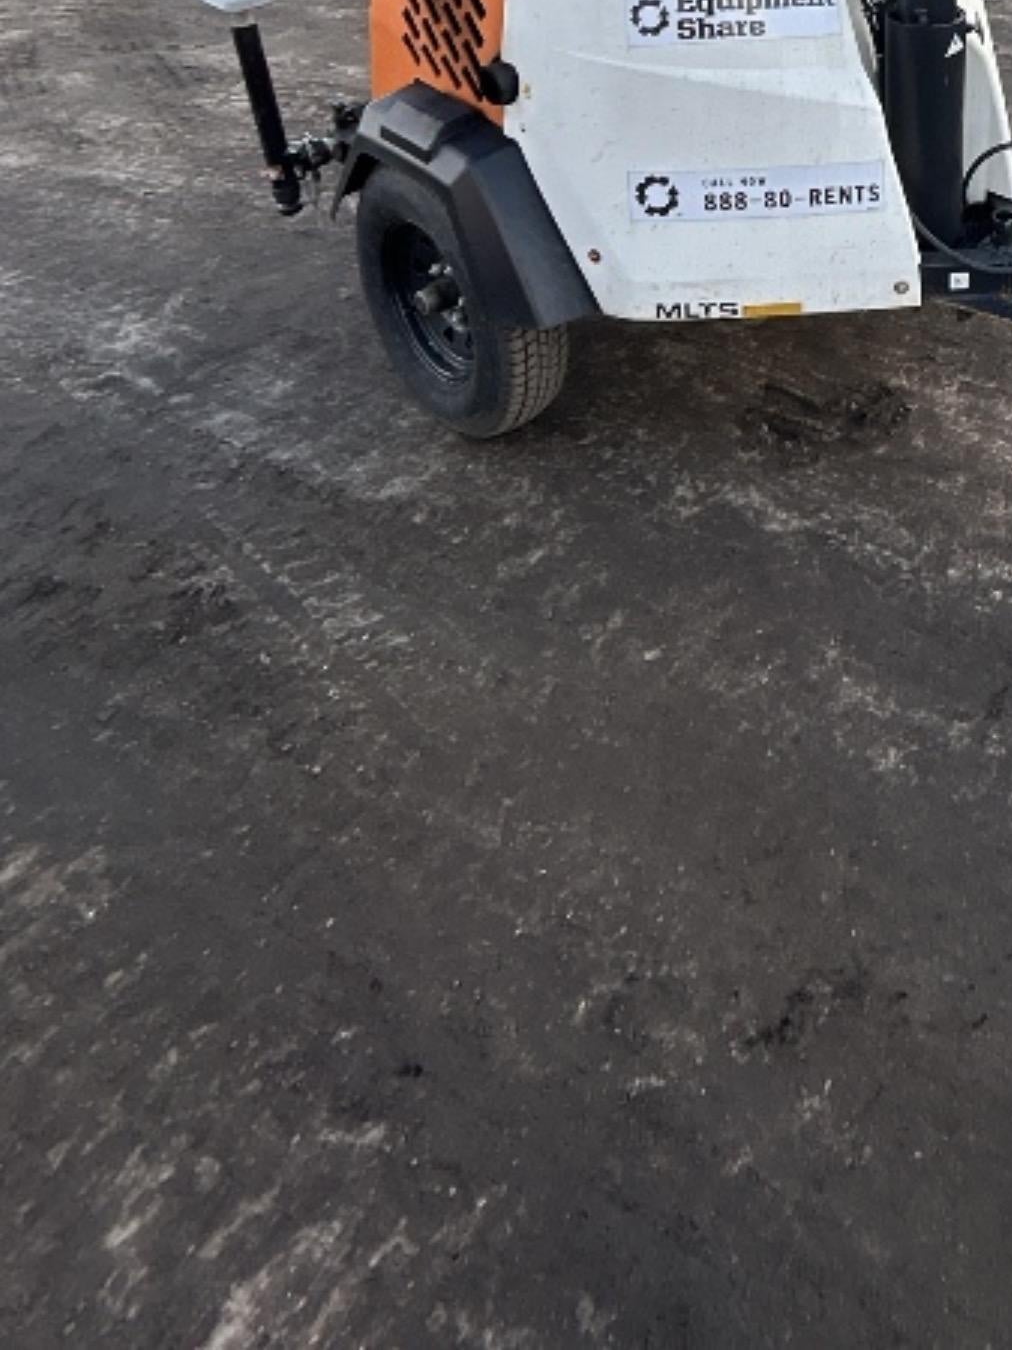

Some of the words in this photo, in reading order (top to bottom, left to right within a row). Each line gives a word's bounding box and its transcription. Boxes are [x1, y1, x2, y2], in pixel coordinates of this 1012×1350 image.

[677, 17, 766, 39] Share
[703, 185, 880, 211] 888-80-RENTS
[656, 302, 739, 319] MLTS
